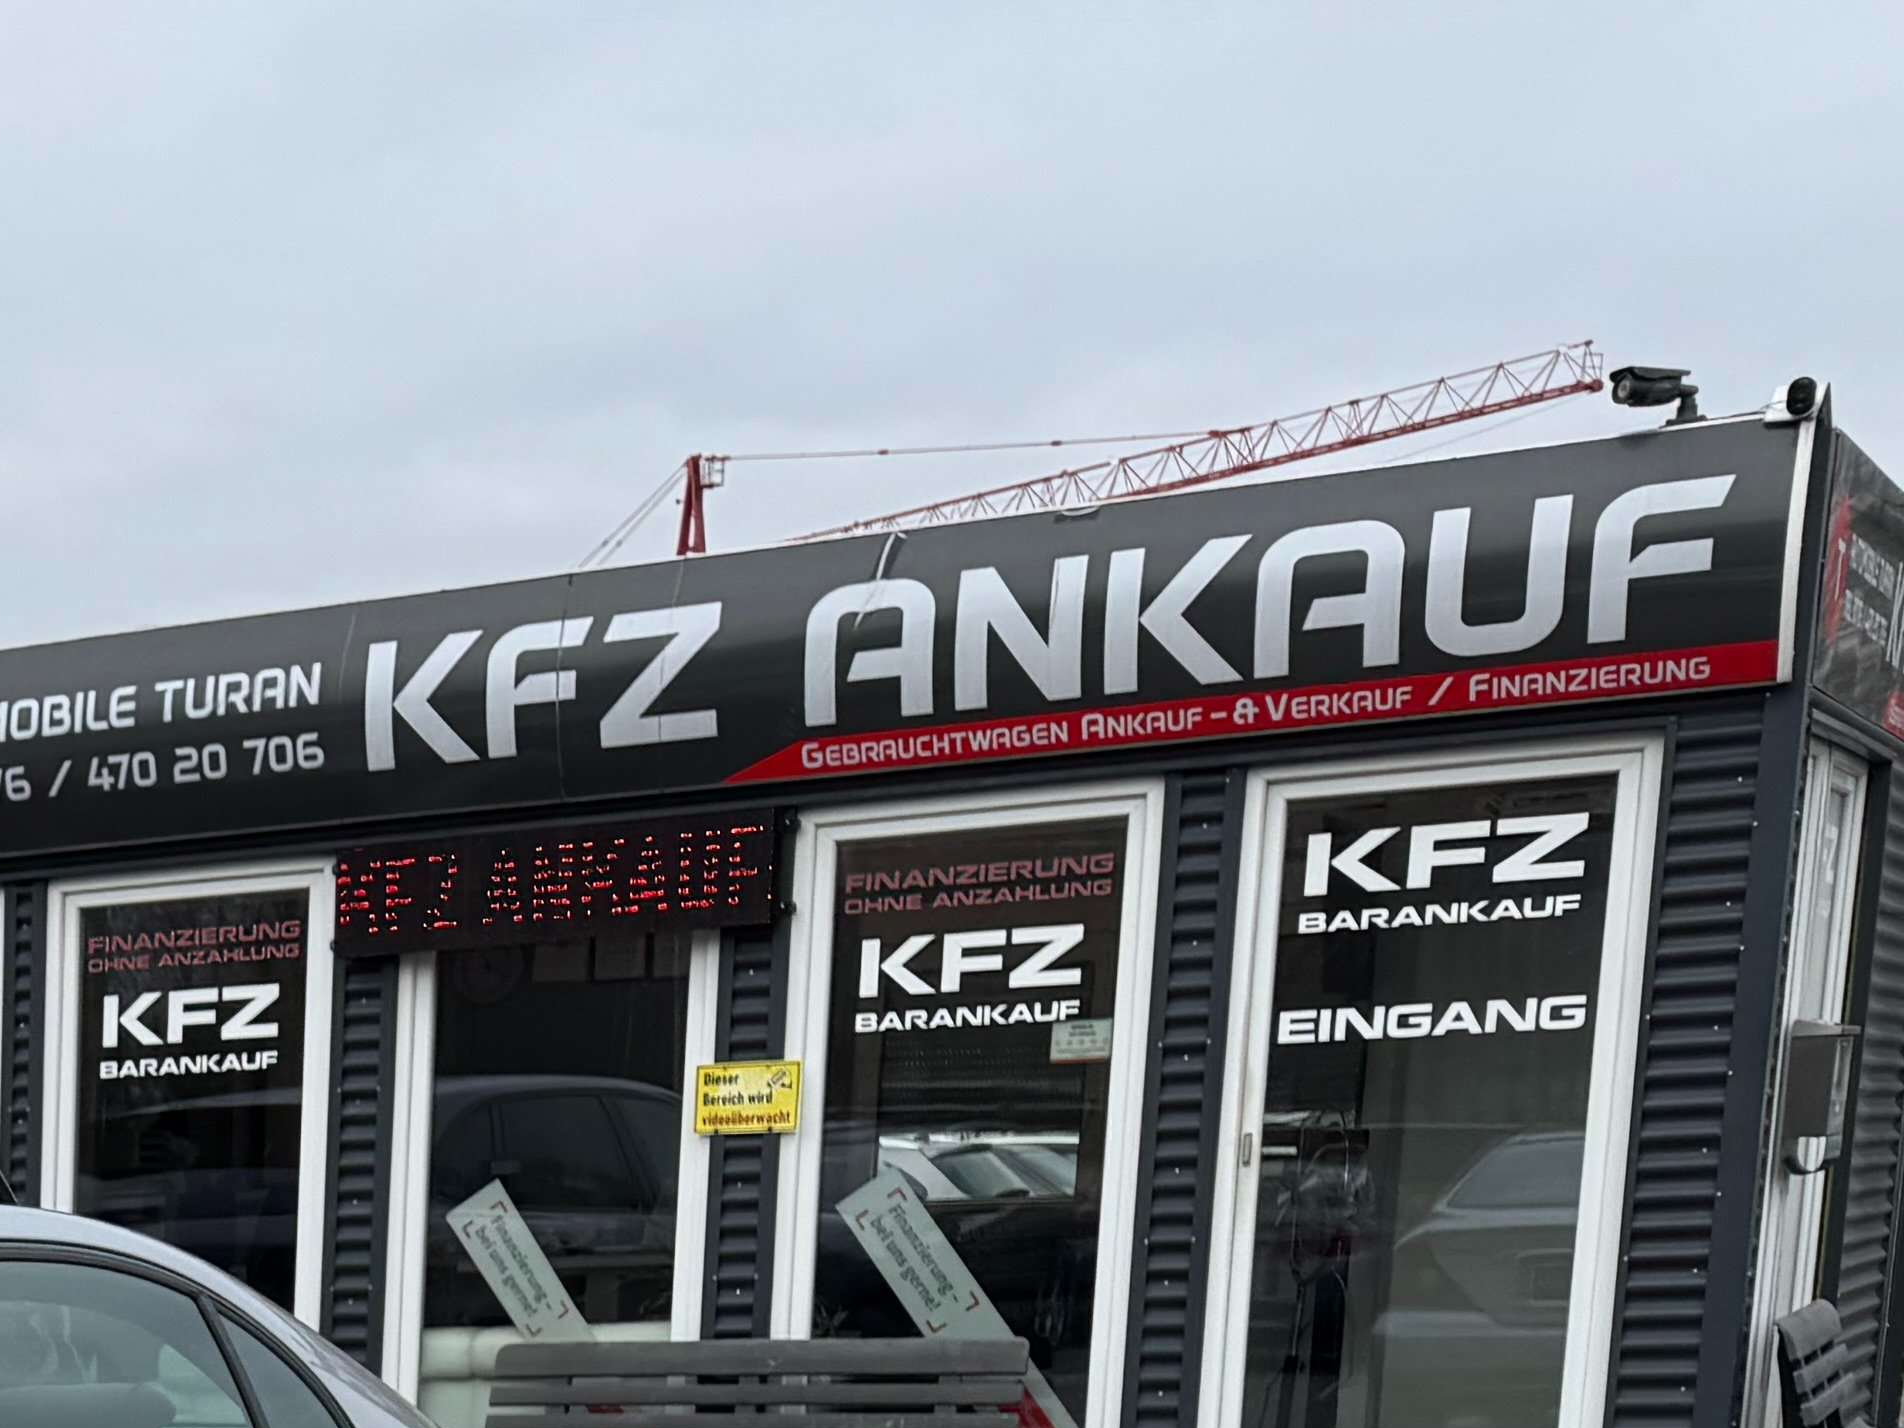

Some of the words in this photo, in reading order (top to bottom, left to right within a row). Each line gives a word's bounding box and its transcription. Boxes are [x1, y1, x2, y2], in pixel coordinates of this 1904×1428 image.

[364, 600, 722, 772] KFZ
[804, 474, 1736, 727] ANKAUF
[155, 662, 322, 723] TURAN
[48, 760, 72, 798] /
[88, 751, 157, 791] 470
[173, 742, 227, 784] 20
[242, 732, 325, 775] 706
[845, 852, 1115, 893] FINANZIERUNG
[1304, 811, 1590, 897] KFZ
[845, 895, 922, 914] OHNE
[932, 879, 1112, 908] ANZAHLUNG
[1297, 894, 1581, 934] BARANKAUF
[87, 920, 301, 954] FINANZIERUNG
[88, 955, 151, 973] OHNE
[158, 944, 300, 968] ANZAHLUNG
[859, 923, 1084, 998] KFZ
[102, 983, 280, 1048] KFZ
[855, 999, 1080, 1033] BARANKAUF
[1277, 994, 1587, 1045] EINGANG
[99, 1050, 278, 1080] BARANKAUF
[704, 1072, 739, 1087] Dieser
[703, 1090, 745, 1107] Bereich
[748, 1088, 773, 1105] wird
